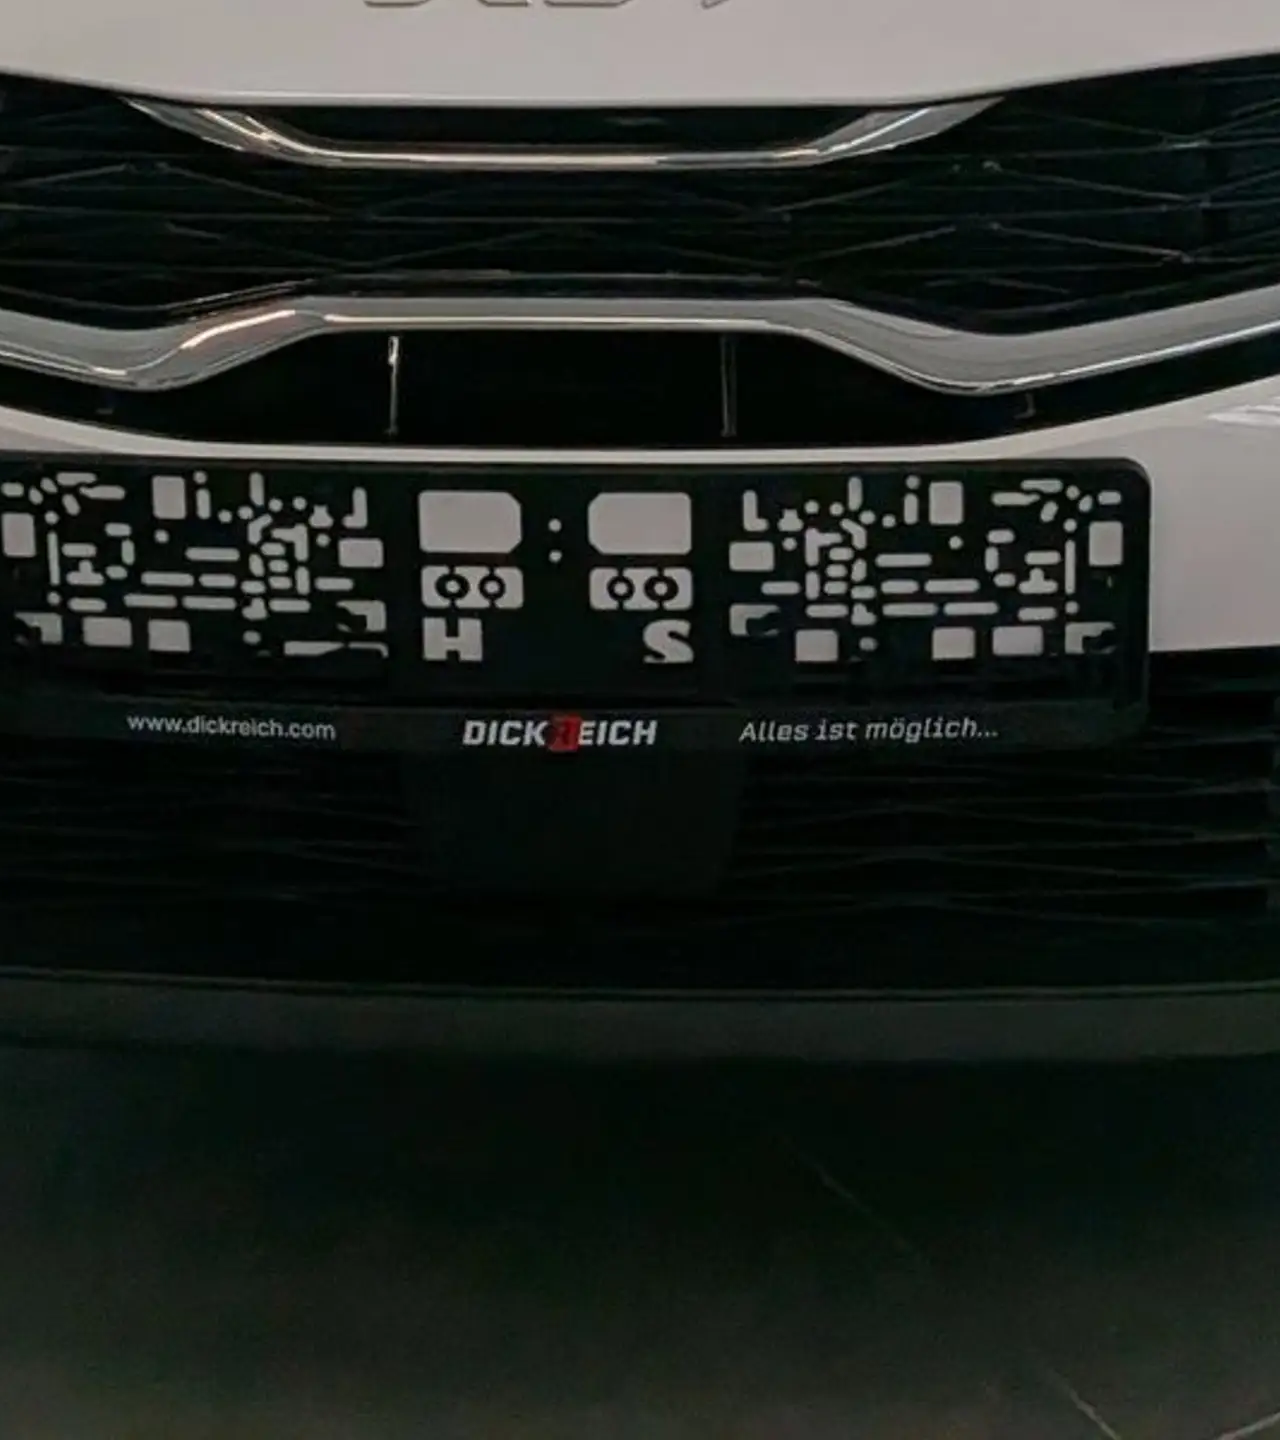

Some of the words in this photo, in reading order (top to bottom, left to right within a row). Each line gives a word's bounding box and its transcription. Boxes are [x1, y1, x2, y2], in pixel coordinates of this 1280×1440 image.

[126, 714, 336, 741] www.dickreich.com
[738, 720, 809, 743] Alles
[815, 719, 860, 741] ist
[865, 717, 1000, 744] möglich...
